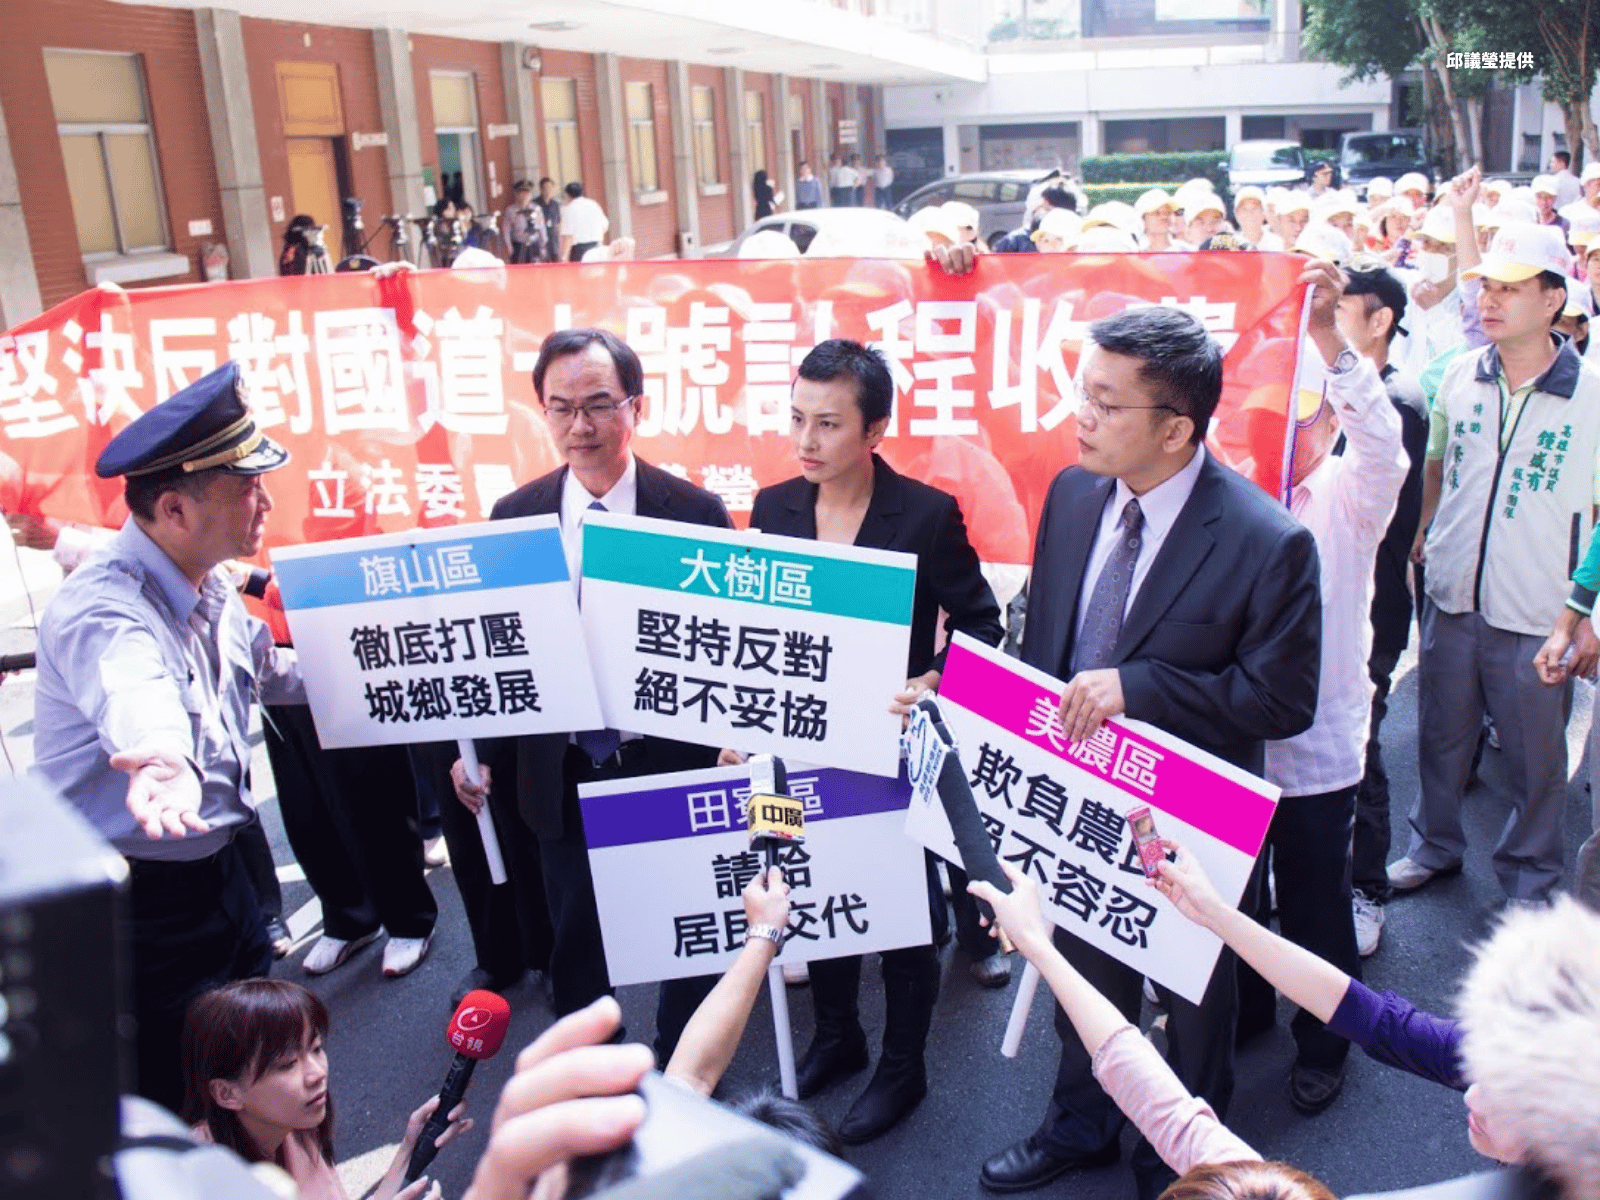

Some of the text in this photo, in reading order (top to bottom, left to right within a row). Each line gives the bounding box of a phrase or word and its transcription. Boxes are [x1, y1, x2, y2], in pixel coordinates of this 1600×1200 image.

[0, 296, 1240, 439] 堅決反對國道號計程收
[359, 544, 482, 596] 旗山區
[679, 549, 814, 606] 大樹區
[350, 611, 530, 671] 徹底打壓
[635, 608, 833, 682] 堅持反對
[364, 669, 542, 724] 城鄉發展
[633, 667, 828, 742] 絕不妥協
[1024, 696, 1164, 796] 美濃區
[452, 1030, 483, 1052] 台視
